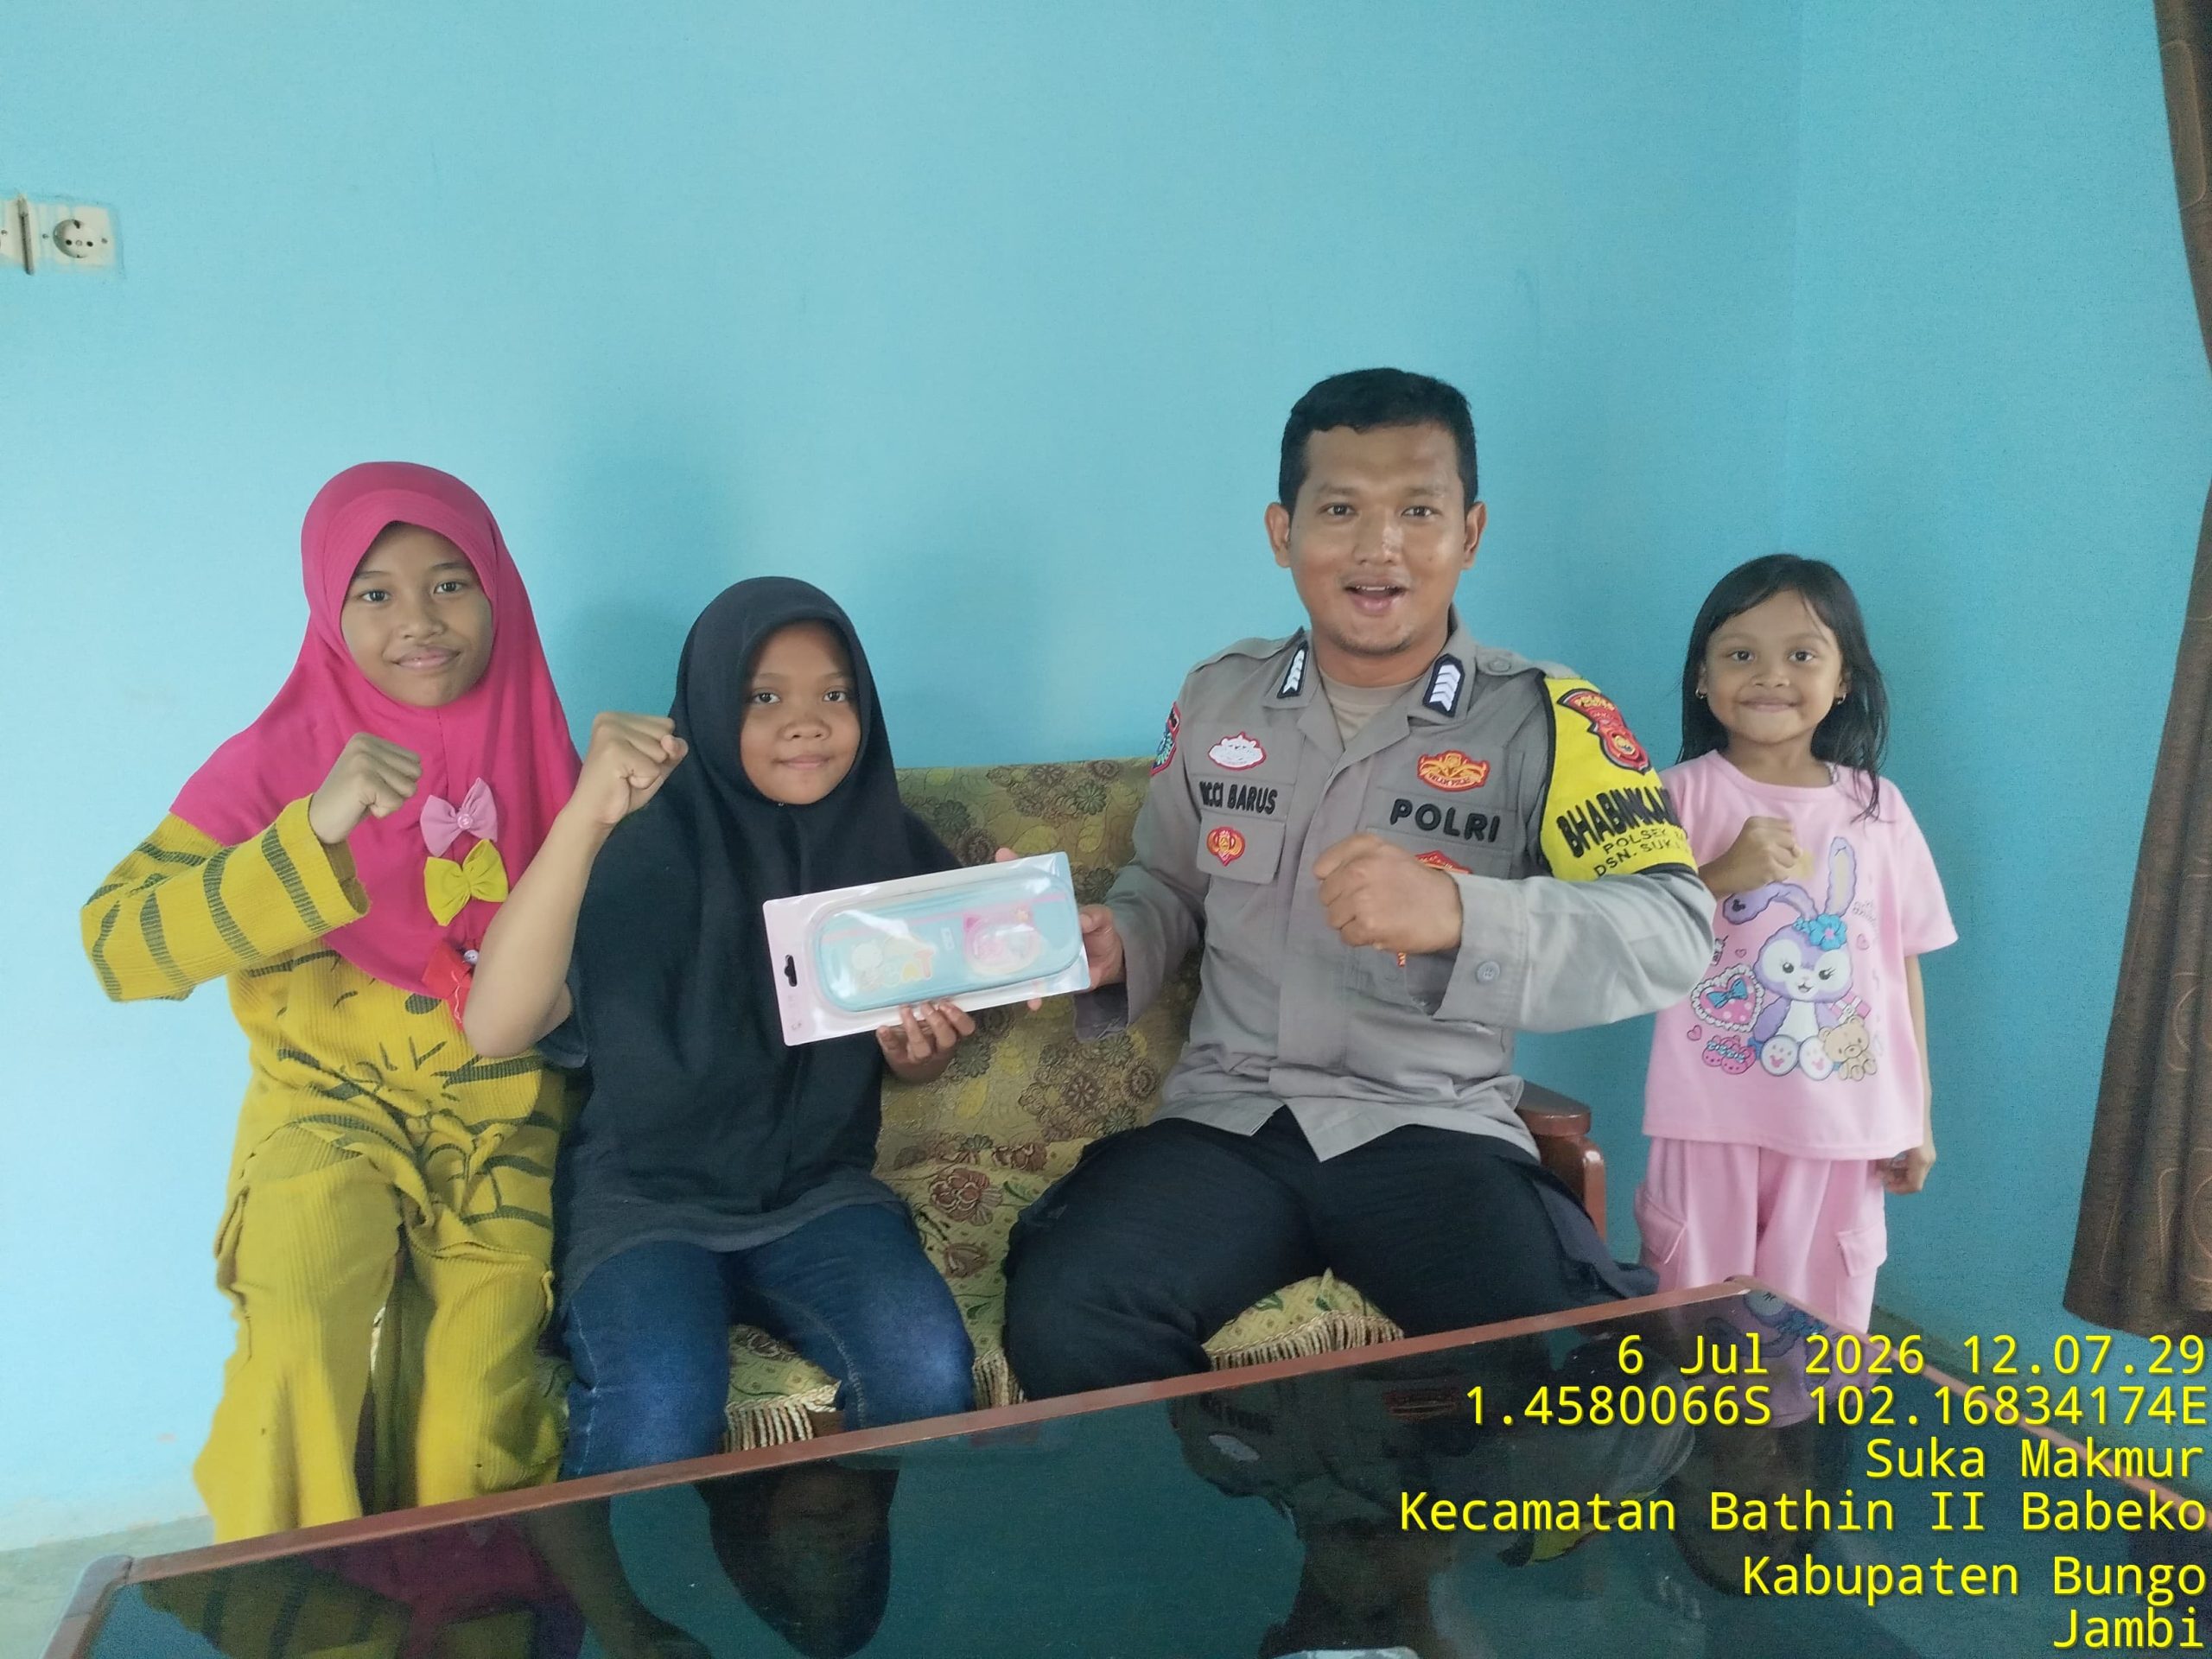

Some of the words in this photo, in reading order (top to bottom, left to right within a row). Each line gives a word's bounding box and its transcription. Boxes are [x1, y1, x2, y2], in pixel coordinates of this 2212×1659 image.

[1227, 783, 1278, 815] BARUS
[1389, 798, 1501, 843] POLRI
[1593, 848, 1637, 876] DSN.
